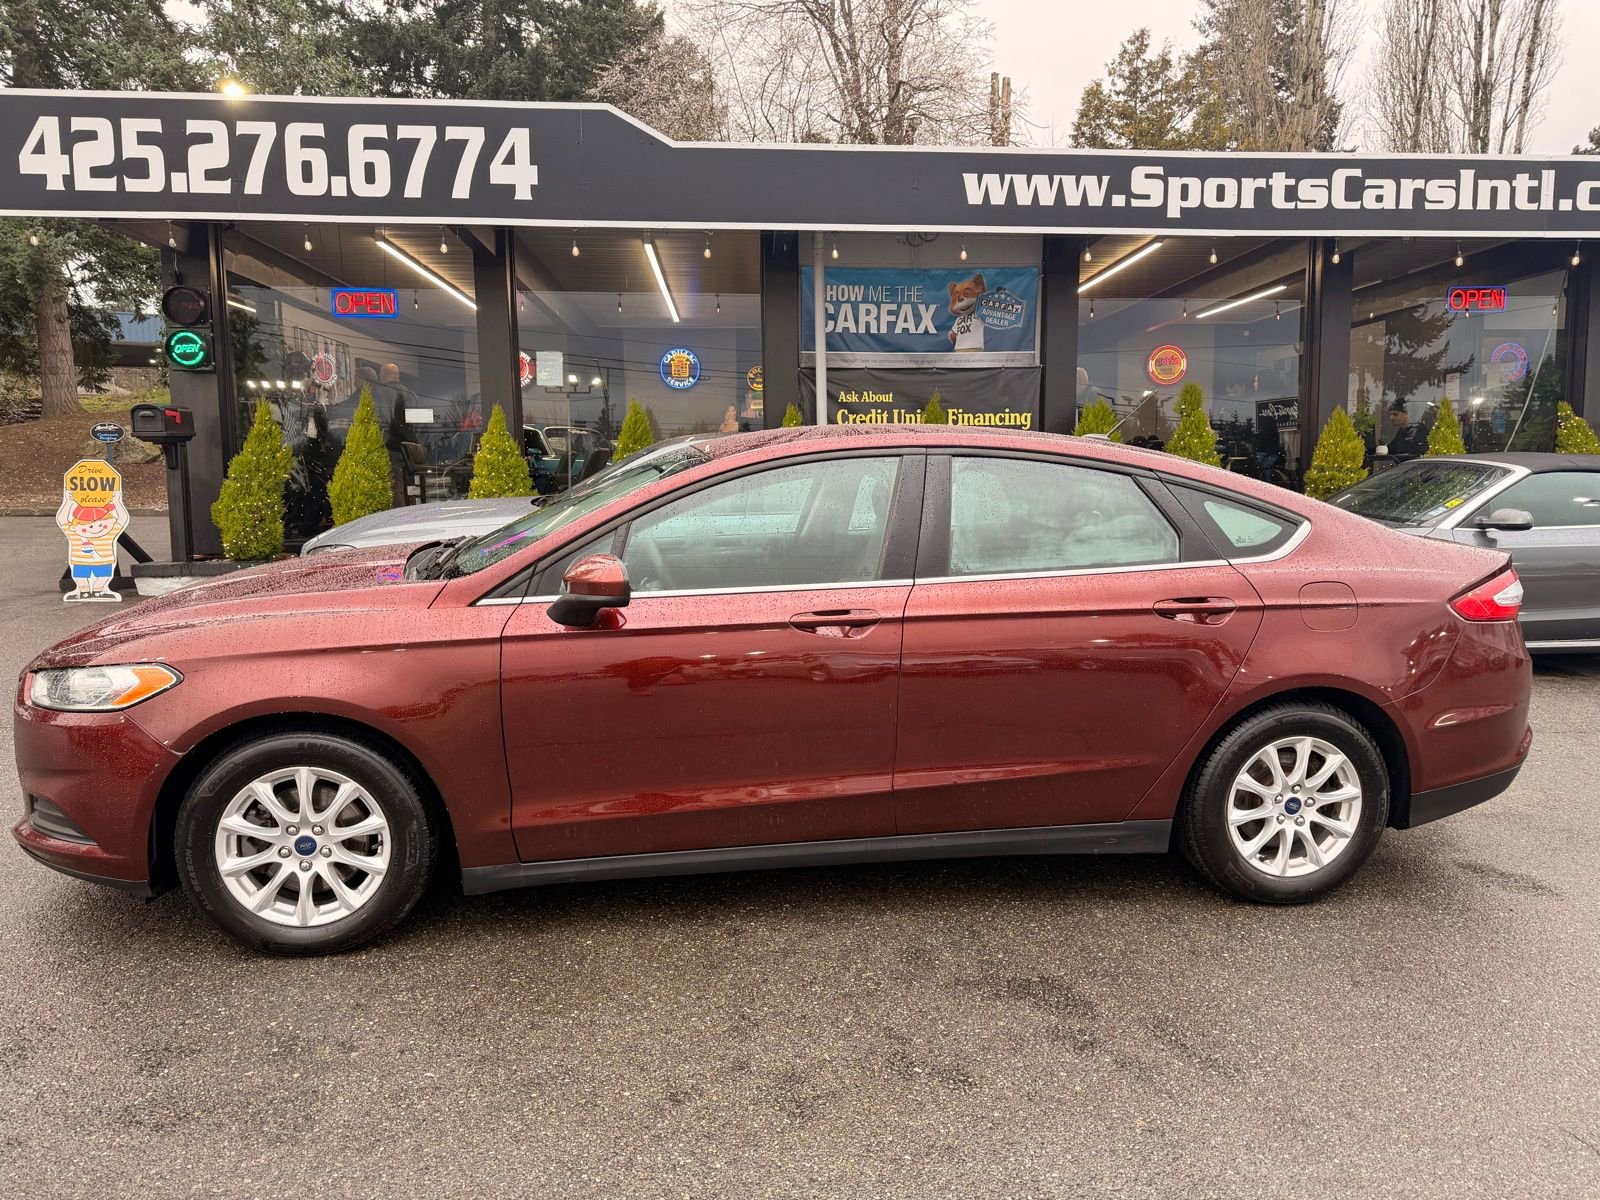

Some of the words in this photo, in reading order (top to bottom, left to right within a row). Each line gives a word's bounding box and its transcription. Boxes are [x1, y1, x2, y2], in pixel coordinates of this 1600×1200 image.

[18, 116, 539, 201] 425.276.6774
[869, 286, 891, 302] ME
[895, 286, 922, 302] THE
[1450, 289, 1504, 309] OPEN
[336, 292, 395, 314] OPEN
[981, 299, 1021, 313] CARFAX
[981, 308, 1016, 321] ADVANTAGE
[985, 317, 1009, 327] DEALER
[956, 324, 972, 336] FOX
[174, 344, 200, 353] OPEN
[838, 391, 859, 402] Ask
[861, 391, 893, 402] About
[837, 409, 888, 425] Credit
[948, 408, 1032, 429] Financing
[78, 465, 103, 473] Drive
[70, 476, 116, 491] SLOW
[80, 495, 107, 503] please
